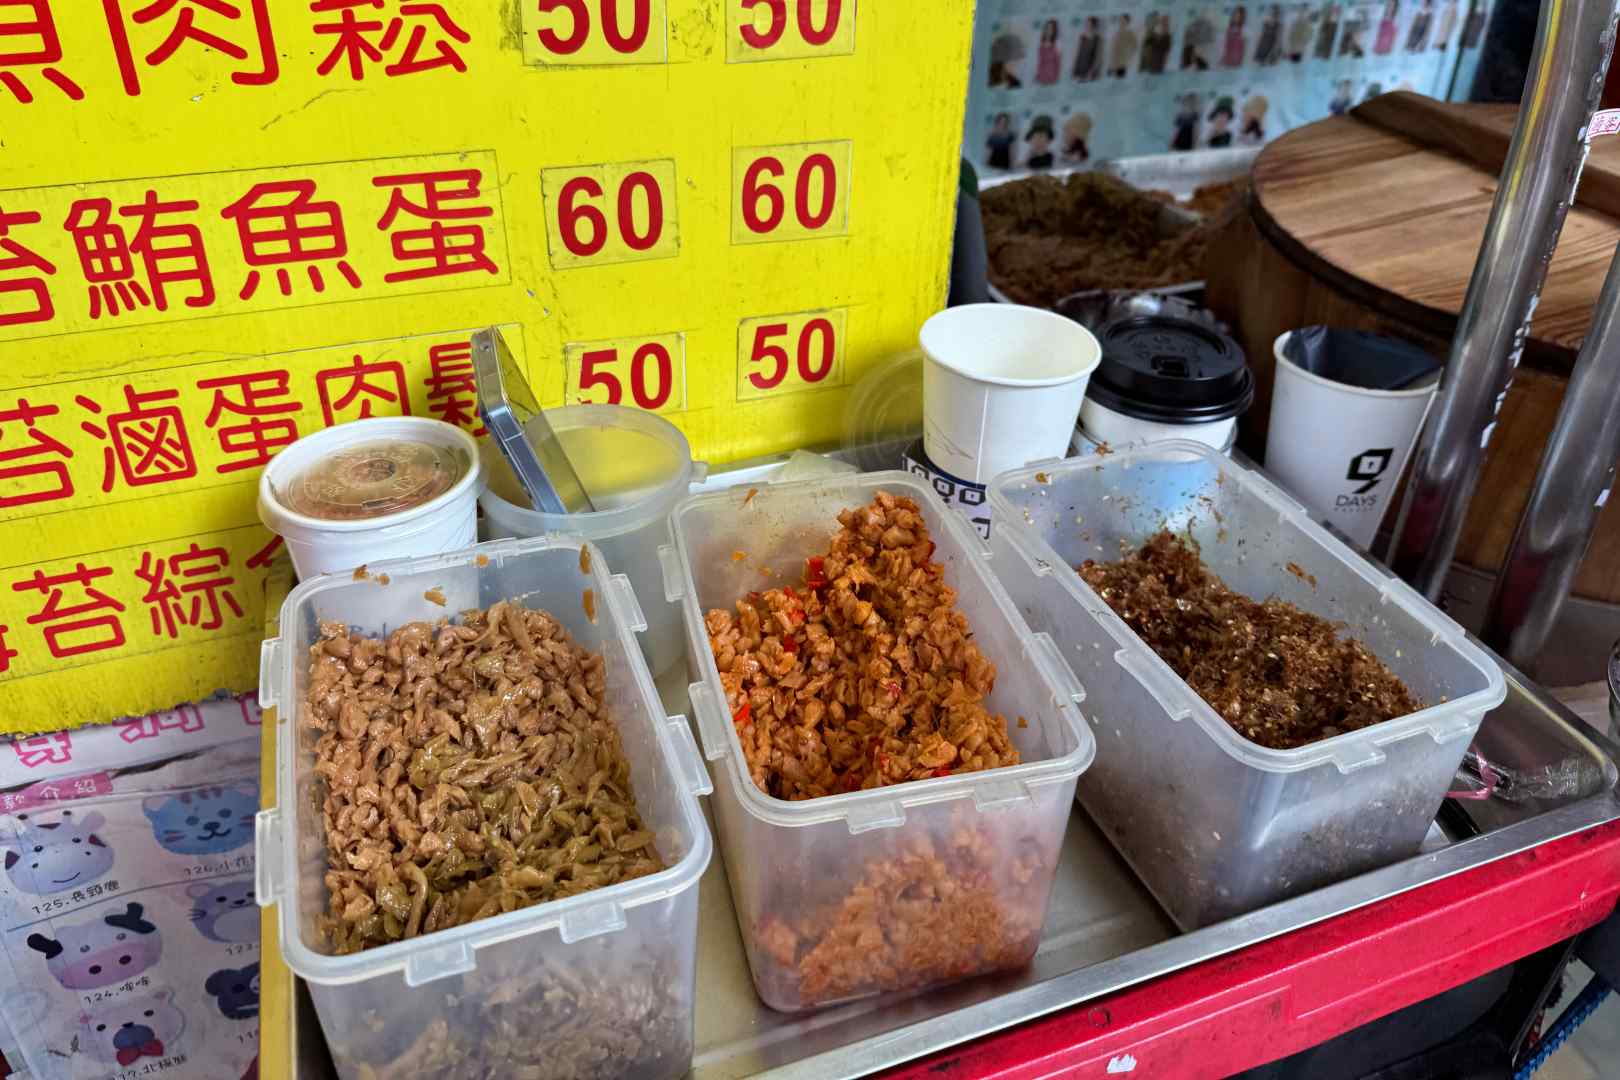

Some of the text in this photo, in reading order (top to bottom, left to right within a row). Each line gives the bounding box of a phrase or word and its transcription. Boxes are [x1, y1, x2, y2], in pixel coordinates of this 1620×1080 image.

[537, 0, 651, 55] 50
[739, 0, 842, 50] 50
[557, 171, 664, 257] 60
[741, 153, 837, 234] 60
[577, 342, 673, 410] 50
[748, 317, 835, 390] 50
